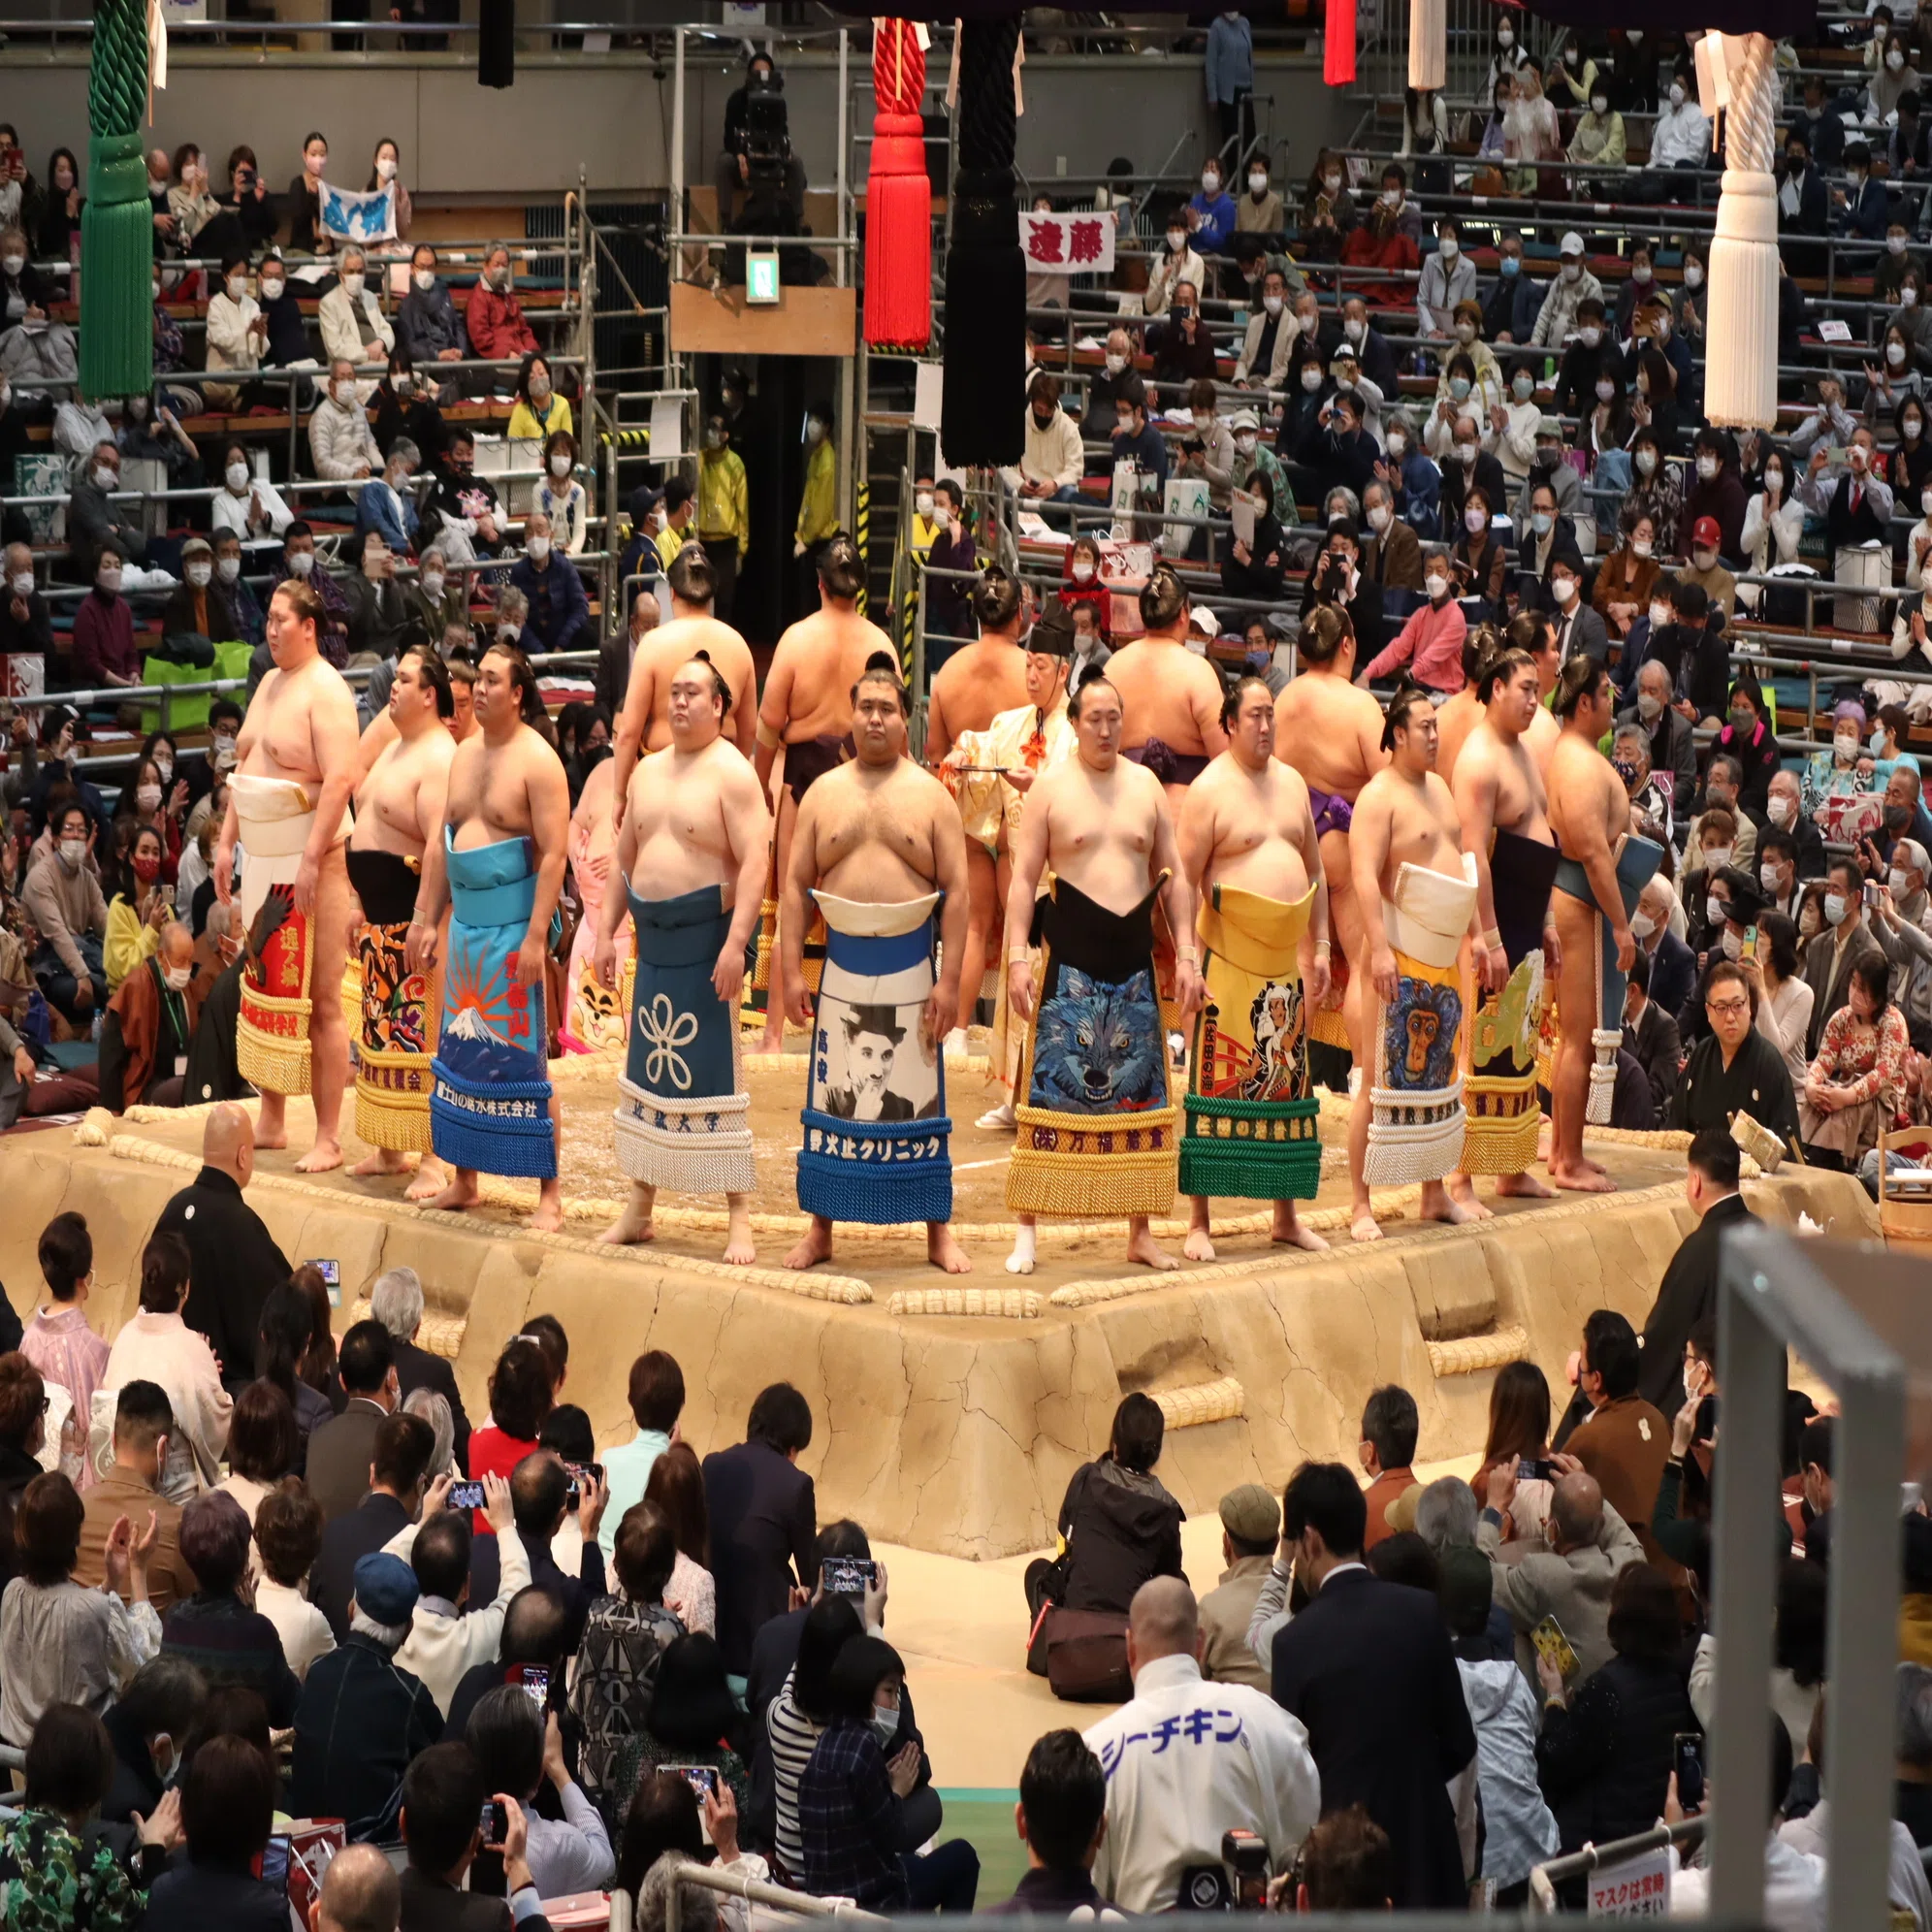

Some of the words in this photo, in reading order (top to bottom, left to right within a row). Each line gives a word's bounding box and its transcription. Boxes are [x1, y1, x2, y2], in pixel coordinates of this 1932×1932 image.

[1028, 219, 1103, 264] 遠藤
[817, 1028, 828, 1084] 高安
[632, 1098, 720, 1133] 近畿大学
[810, 1128, 940, 1162] 野火止クリニック
[1102, 1709, 1242, 1782] シーチキン
[1594, 1871, 1664, 1909] マスクは常時
